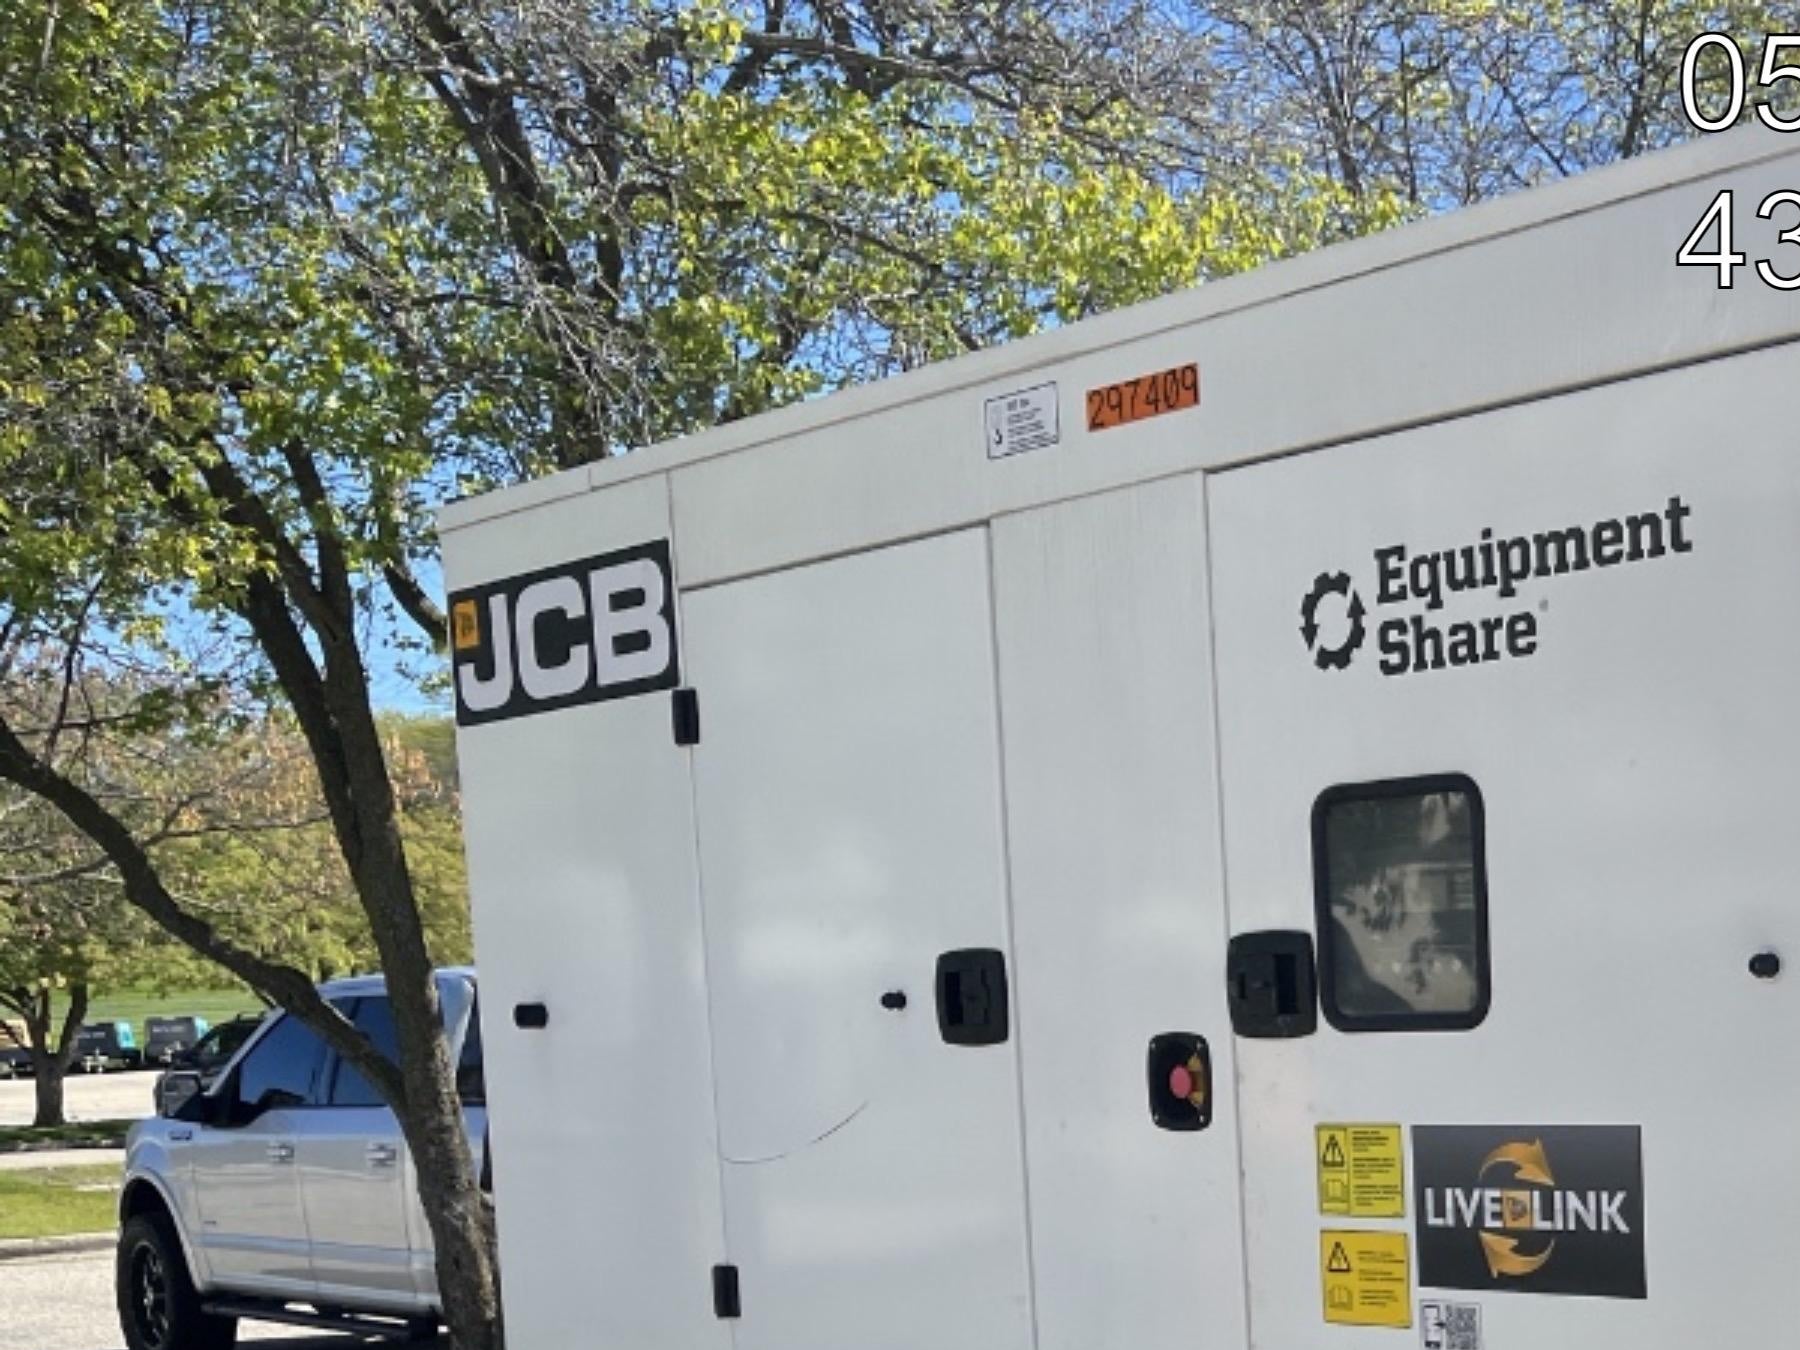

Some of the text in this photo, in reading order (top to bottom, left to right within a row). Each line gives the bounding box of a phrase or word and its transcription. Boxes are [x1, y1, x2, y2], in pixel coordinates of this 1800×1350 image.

[1088, 366, 1198, 430] 297409
[1374, 496, 1692, 609] Equipment
[458, 557, 670, 712] JCB
[1379, 611, 1537, 676] Share
[1425, 1187, 1630, 1234] LIVE LINK
